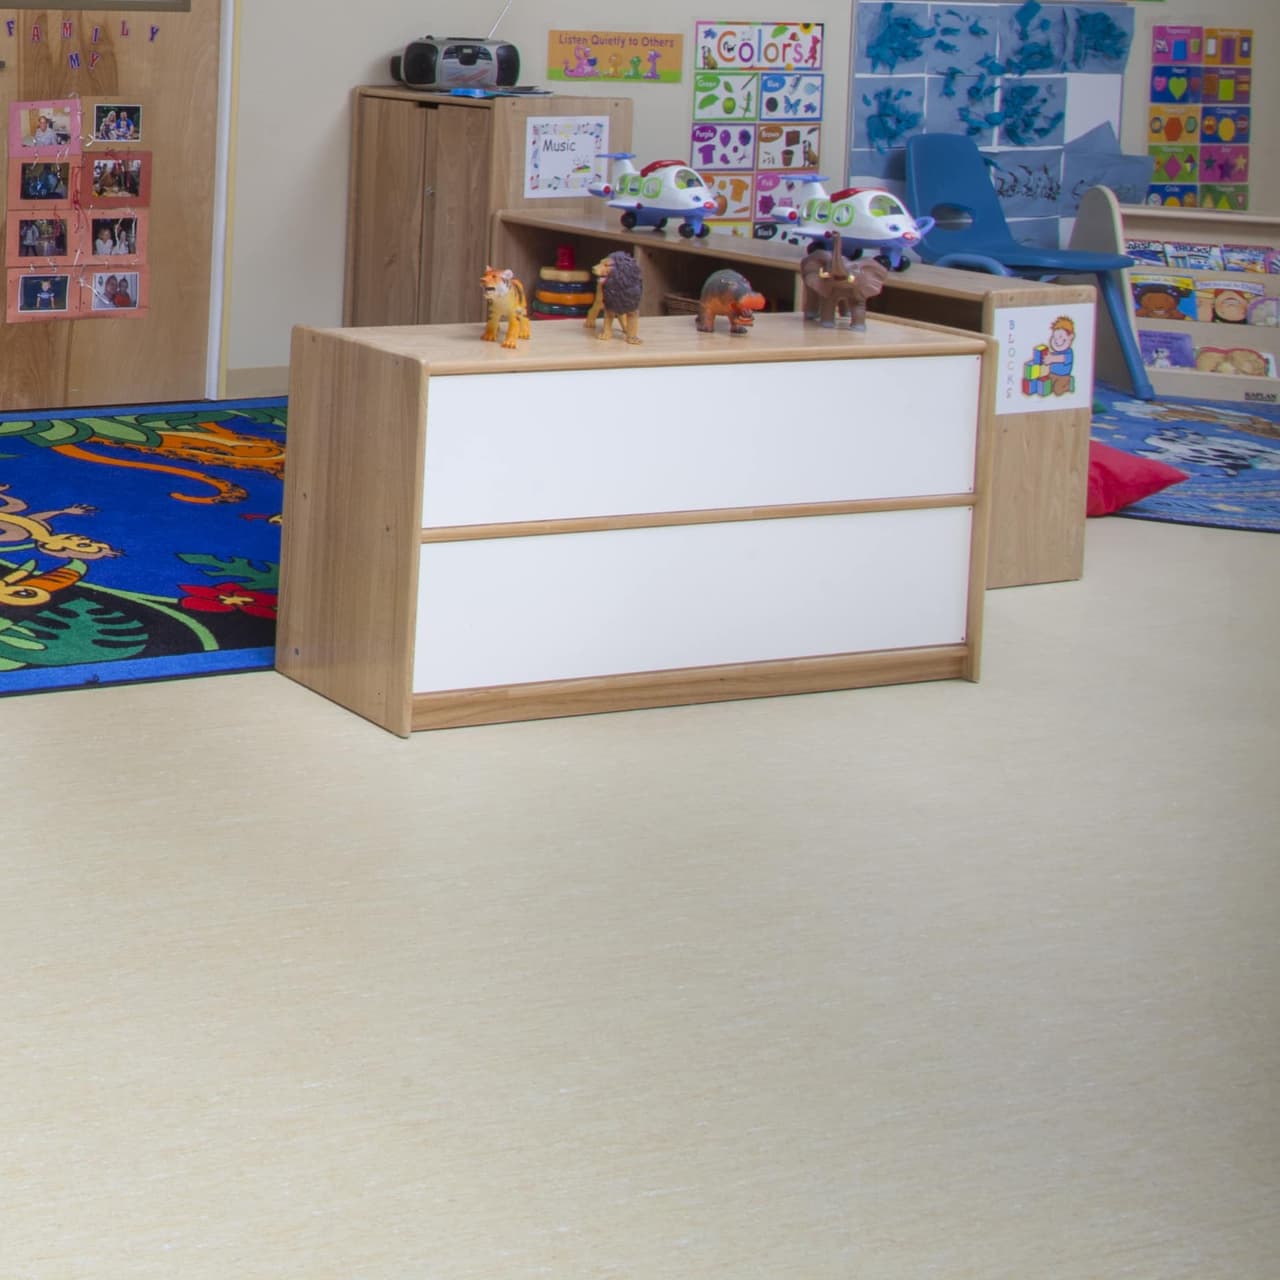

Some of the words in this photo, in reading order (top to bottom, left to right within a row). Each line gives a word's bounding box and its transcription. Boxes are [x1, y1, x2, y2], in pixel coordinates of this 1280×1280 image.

[559, 34, 588, 45] Listen
[591, 34, 626, 48] Quietly
[628, 36, 638, 46] to
[641, 36, 675, 48] Others
[716, 28, 804, 64] Colors
[69, 51, 100, 70] MY
[543, 139, 576, 152] Music
